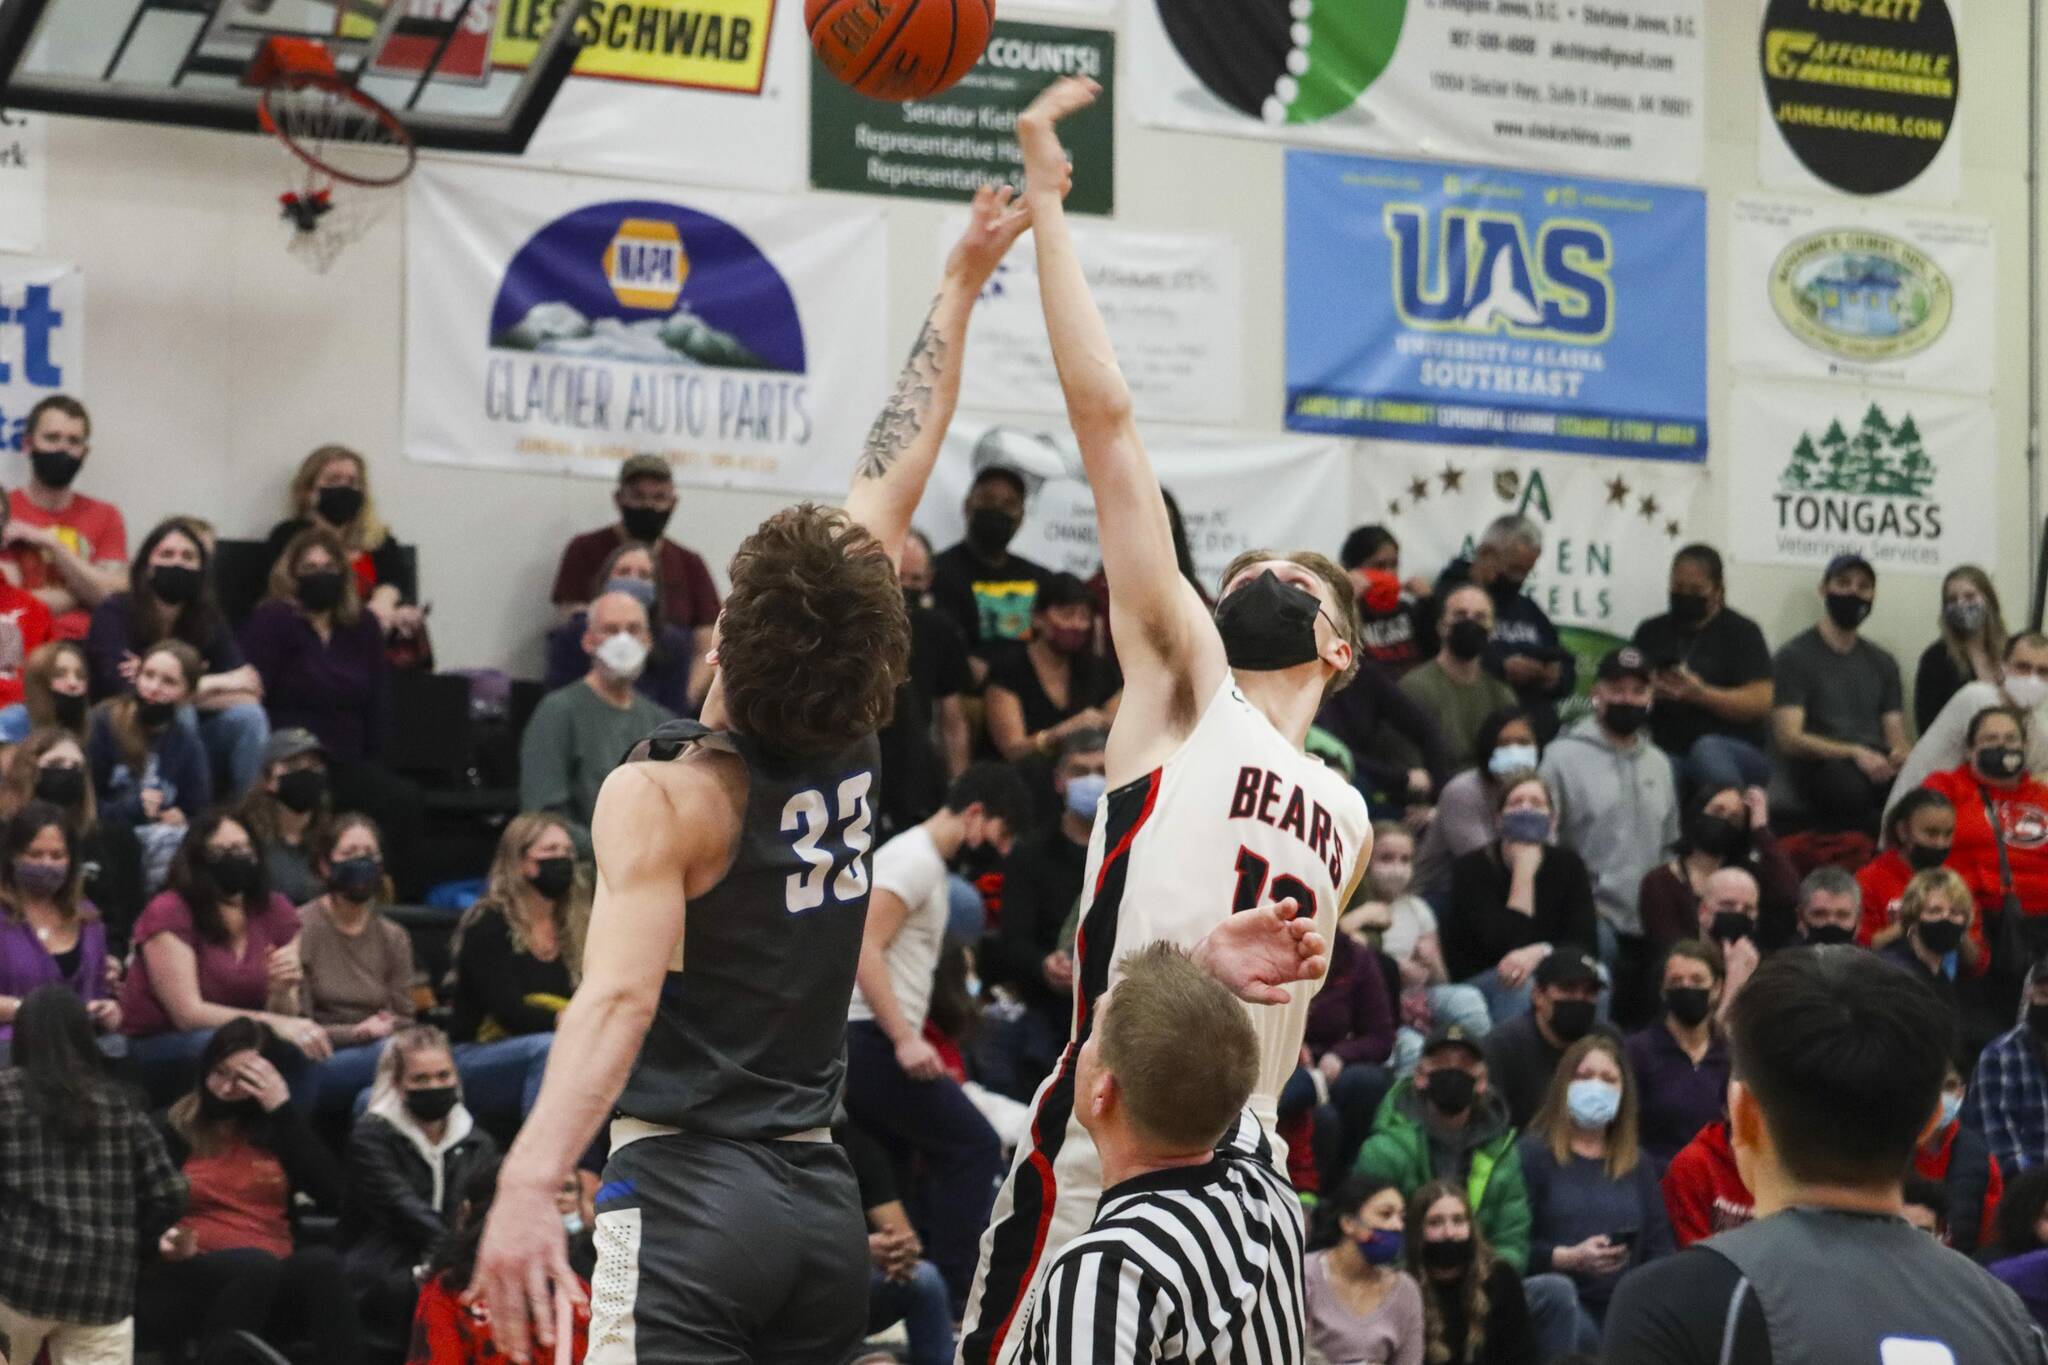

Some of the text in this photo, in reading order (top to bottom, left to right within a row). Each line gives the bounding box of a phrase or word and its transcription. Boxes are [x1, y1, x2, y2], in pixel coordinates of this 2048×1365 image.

[572, 2, 752, 62] SCHWAB
[987, 36, 1101, 76] COUNTS!
[1808, 41, 1951, 78] AFFORDABLE
[902, 100, 977, 128] Senator
[1777, 103, 1945, 141] JUNEAUCARS.COM
[855, 122, 995, 162] Representative
[866, 156, 1007, 191] Representative
[614, 244, 676, 285] NAPA
[1384, 203, 1615, 344] UAS
[1420, 358, 1586, 398] SOUTHEAST
[485, 358, 813, 446] GLACIER AUTO PARTS
[1773, 493, 1942, 540] TONGASS
[777, 768, 875, 916] 33
[1228, 765, 1344, 891] BEARS
